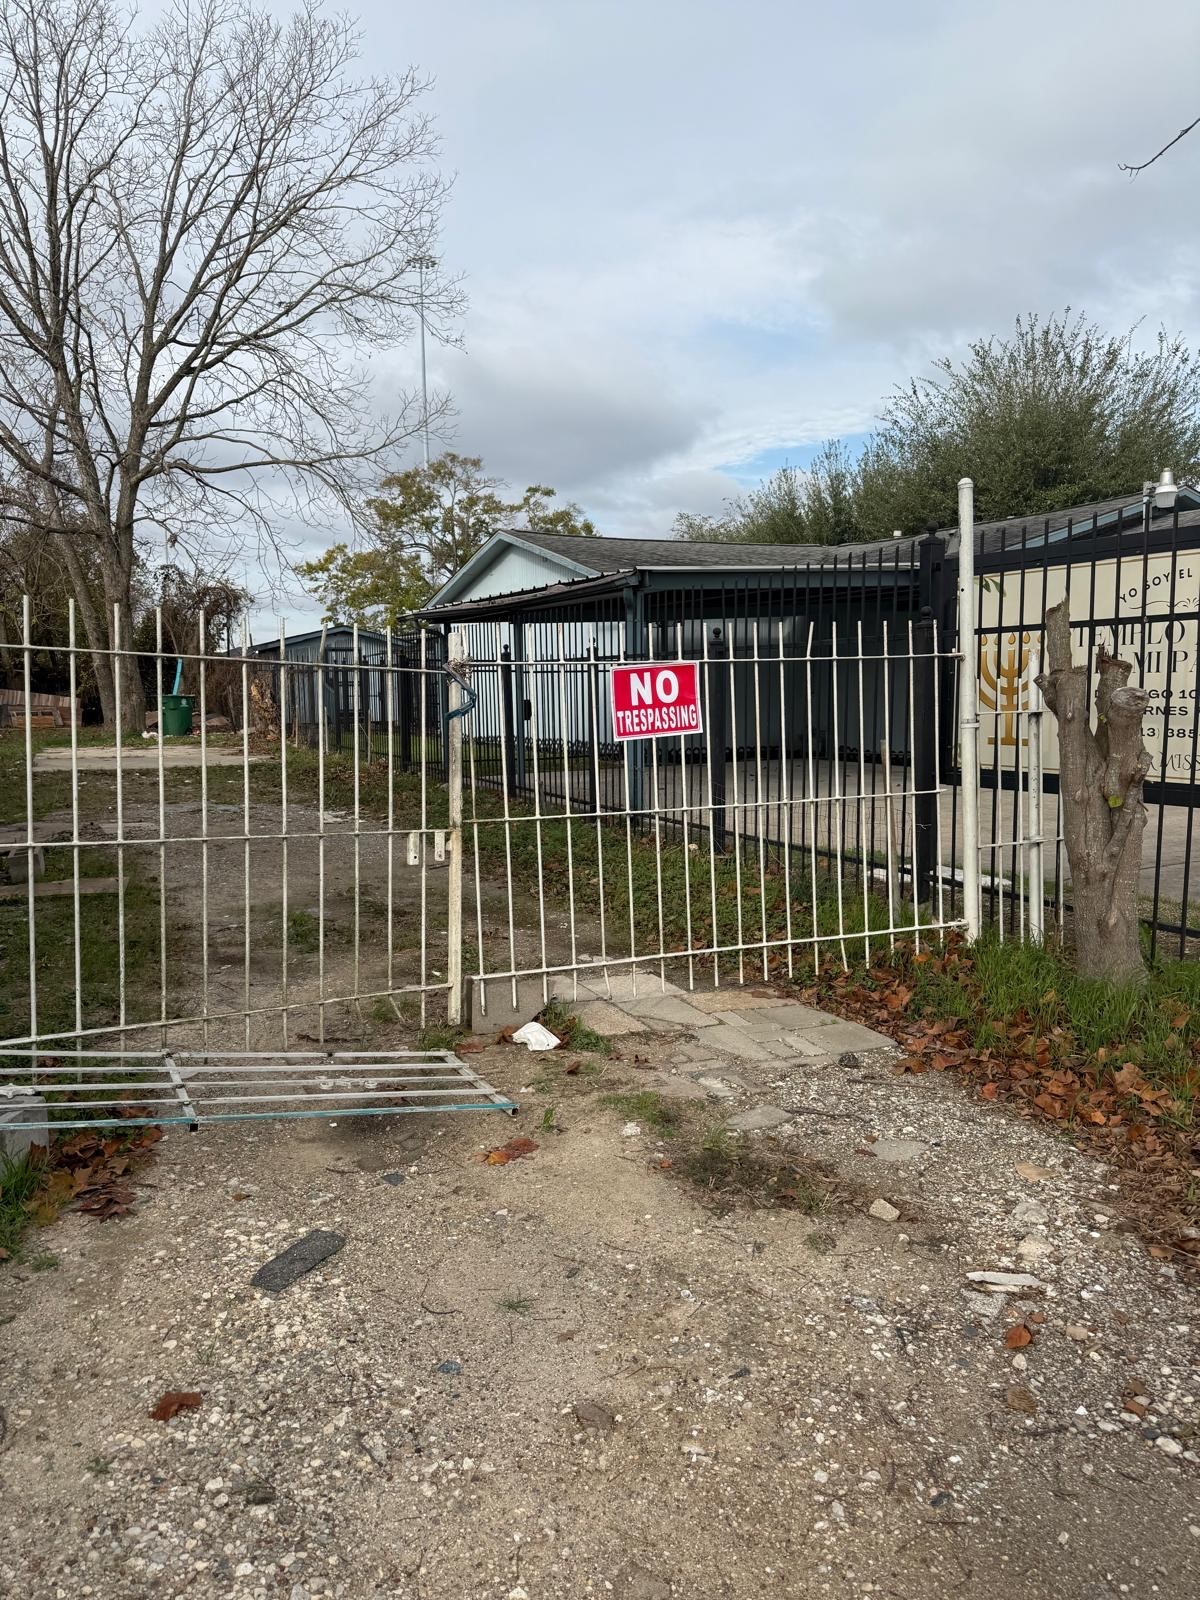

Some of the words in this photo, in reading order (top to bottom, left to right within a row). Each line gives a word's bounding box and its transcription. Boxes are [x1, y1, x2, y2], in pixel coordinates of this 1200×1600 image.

[1119, 588, 1138, 603] YO
[1143, 572, 1170, 590] SOY
[1179, 568, 1193, 579] EL
[1072, 620, 1185, 648] TEMPLO
[630, 669, 679, 706] NO
[617, 704, 697, 734] TRESPASSING
[1143, 706, 1188, 716] RNES
